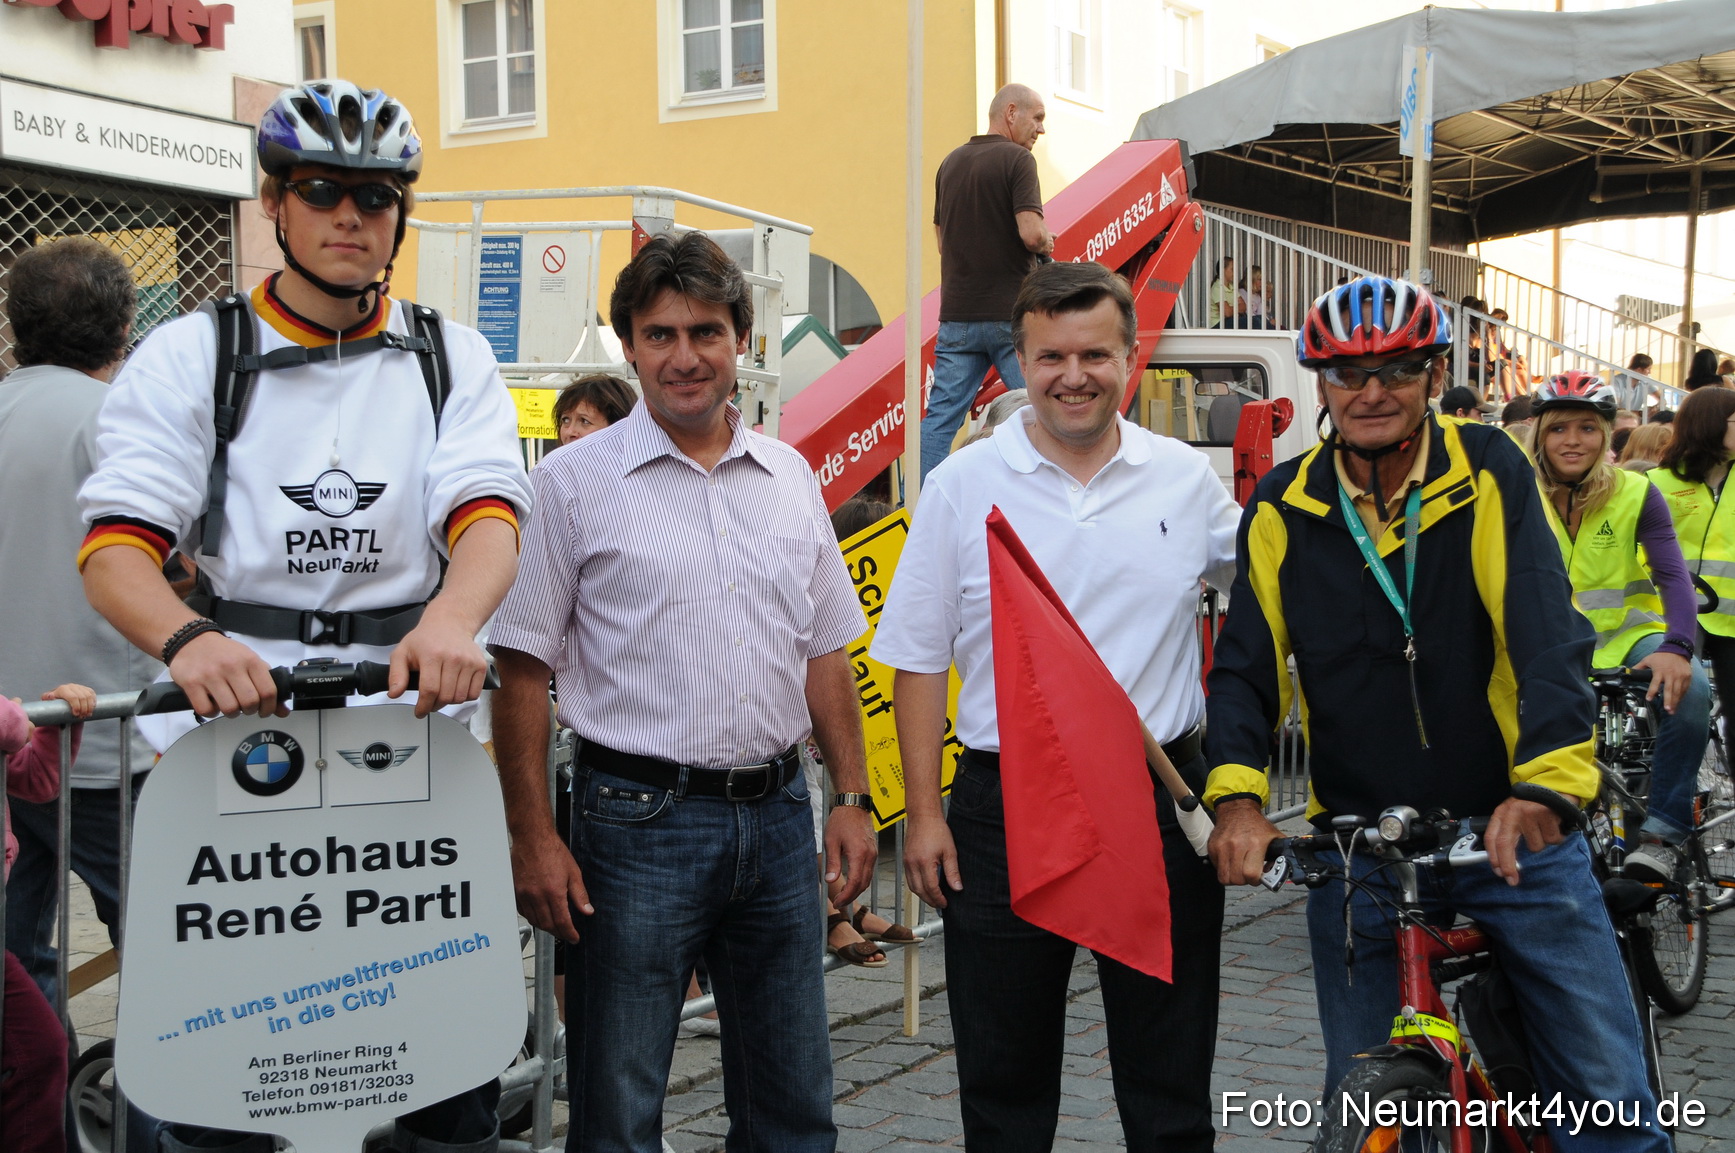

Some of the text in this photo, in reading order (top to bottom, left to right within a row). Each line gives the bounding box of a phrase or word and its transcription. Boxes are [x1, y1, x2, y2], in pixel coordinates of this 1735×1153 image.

[13, 109, 243, 171] BABY & KINDERMODEN
[1086, 191, 1155, 262] 09181 6352
[517, 423, 557, 436] formation
[847, 398, 905, 463] Servic
[319, 488, 353, 500] MINI
[285, 527, 383, 555] PARTL
[306, 676, 343, 684] SEGWAY
[238, 732, 300, 755] BMW
[365, 752, 391, 761] MINI
[186, 836, 459, 885] Autohaus
[175, 880, 471, 943] René Partl
[184, 1006, 226, 1034] mit
[231, 994, 278, 1020] uns
[282, 932, 490, 1005] umweltfreundlich
[268, 981, 397, 1034] in die City!
[248, 1041, 408, 1070] Am Berliner Ring 4
[259, 1059, 398, 1085] 92318 Neumarkt
[242, 1073, 415, 1103] Telefon 09181/32033
[248, 1091, 408, 1119] www.bmw-partl.de
